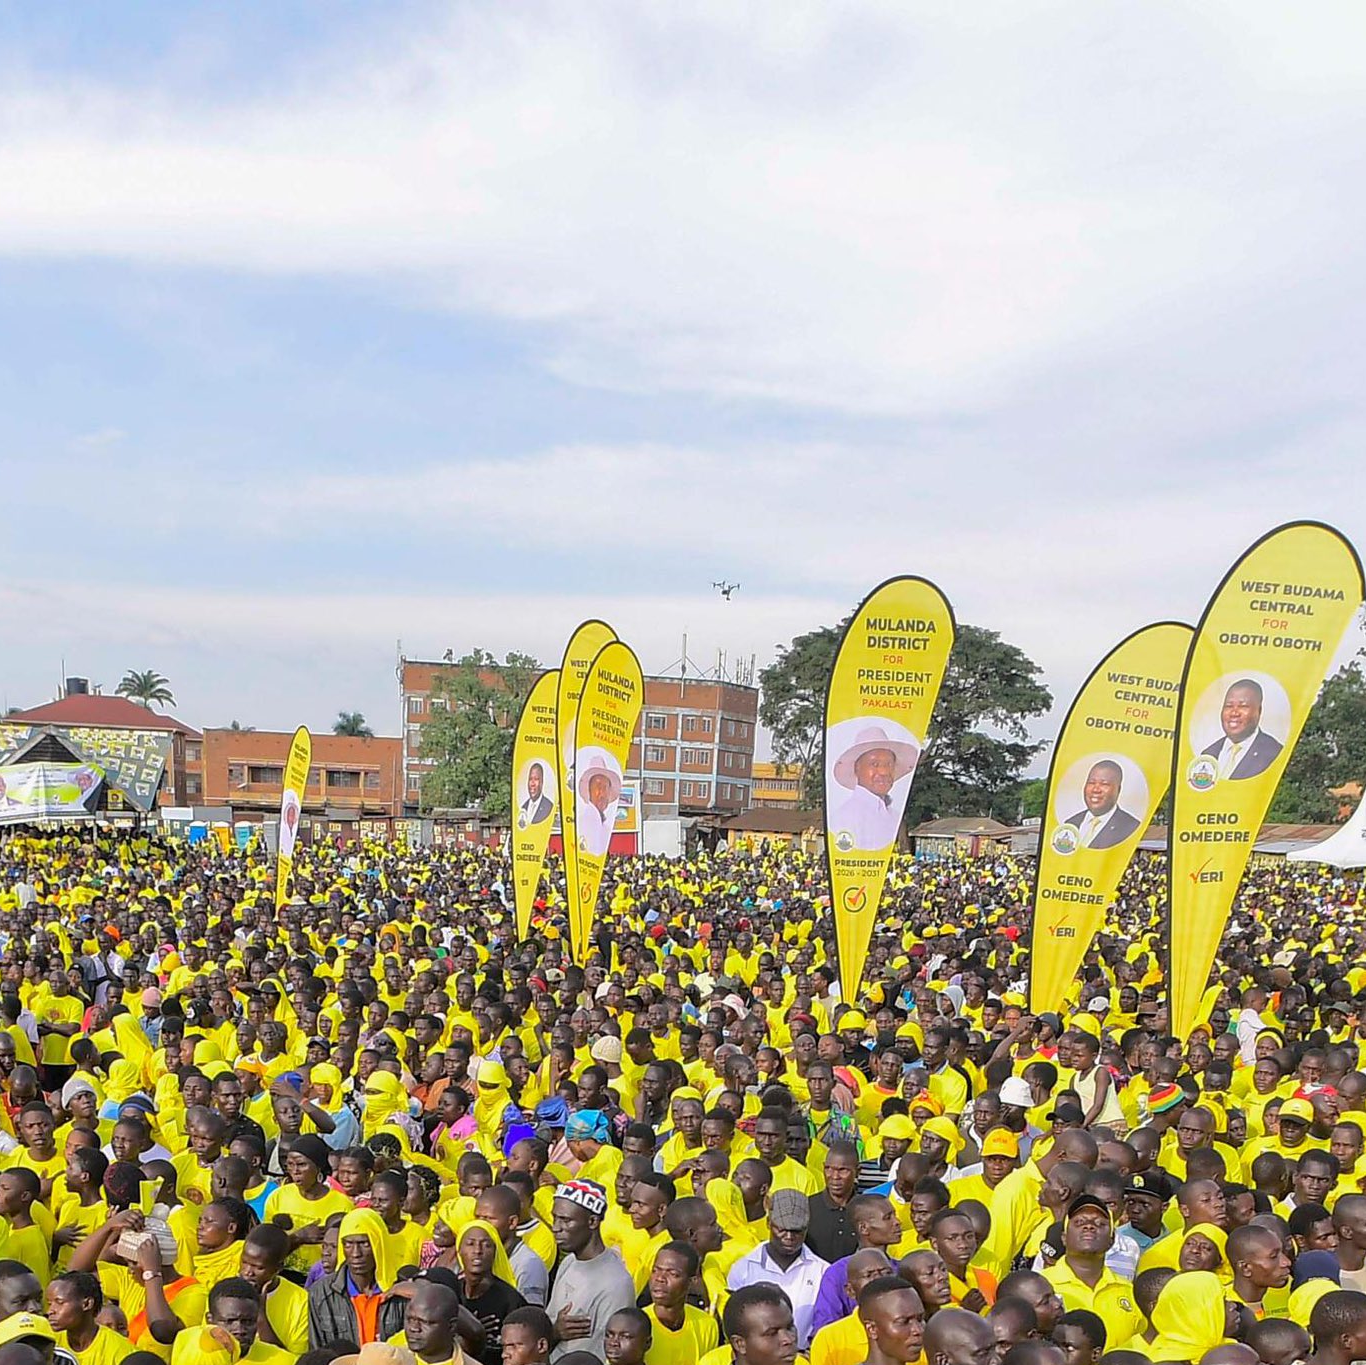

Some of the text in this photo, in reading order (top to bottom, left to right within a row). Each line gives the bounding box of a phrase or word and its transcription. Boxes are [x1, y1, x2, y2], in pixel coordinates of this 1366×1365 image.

[1241, 580, 1345, 601] WEST BUDAMA
[1250, 599, 1314, 616] CENTRAL
[866, 618, 936, 633] MULANDA
[1262, 618, 1288, 630] FOR
[867, 635, 930, 650] DISTRICT
[1219, 632, 1322, 652] OBOTH OBOTH
[883, 655, 903, 664] FOR
[597, 668, 635, 692] MULANDA
[857, 668, 933, 684] PRESIDENT
[1107, 672, 1180, 692] WEST BUDA
[597, 682, 632, 704] DISTRICT
[859, 685, 924, 697] MUSEVENI
[862, 698, 913, 709] PAKALAST
[1114, 689, 1173, 709] CENTRAL
[535, 716, 555, 725] CENTR
[591, 707, 629, 731] PRESIDENT
[1125, 706, 1149, 720] FOR
[592, 720, 626, 739] MUSEVENI
[1085, 716, 1131, 732] OBOTH
[1196, 812, 1239, 825] GENO
[1179, 831, 1250, 843] OMEDERE
[835, 859, 885, 868] PRESIDENT
[836, 869, 855, 877] 2026
[1057, 875, 1093, 888] GENO
[1041, 888, 1104, 905] OMEDERE
[555, 1184, 606, 1214] ICAGO
